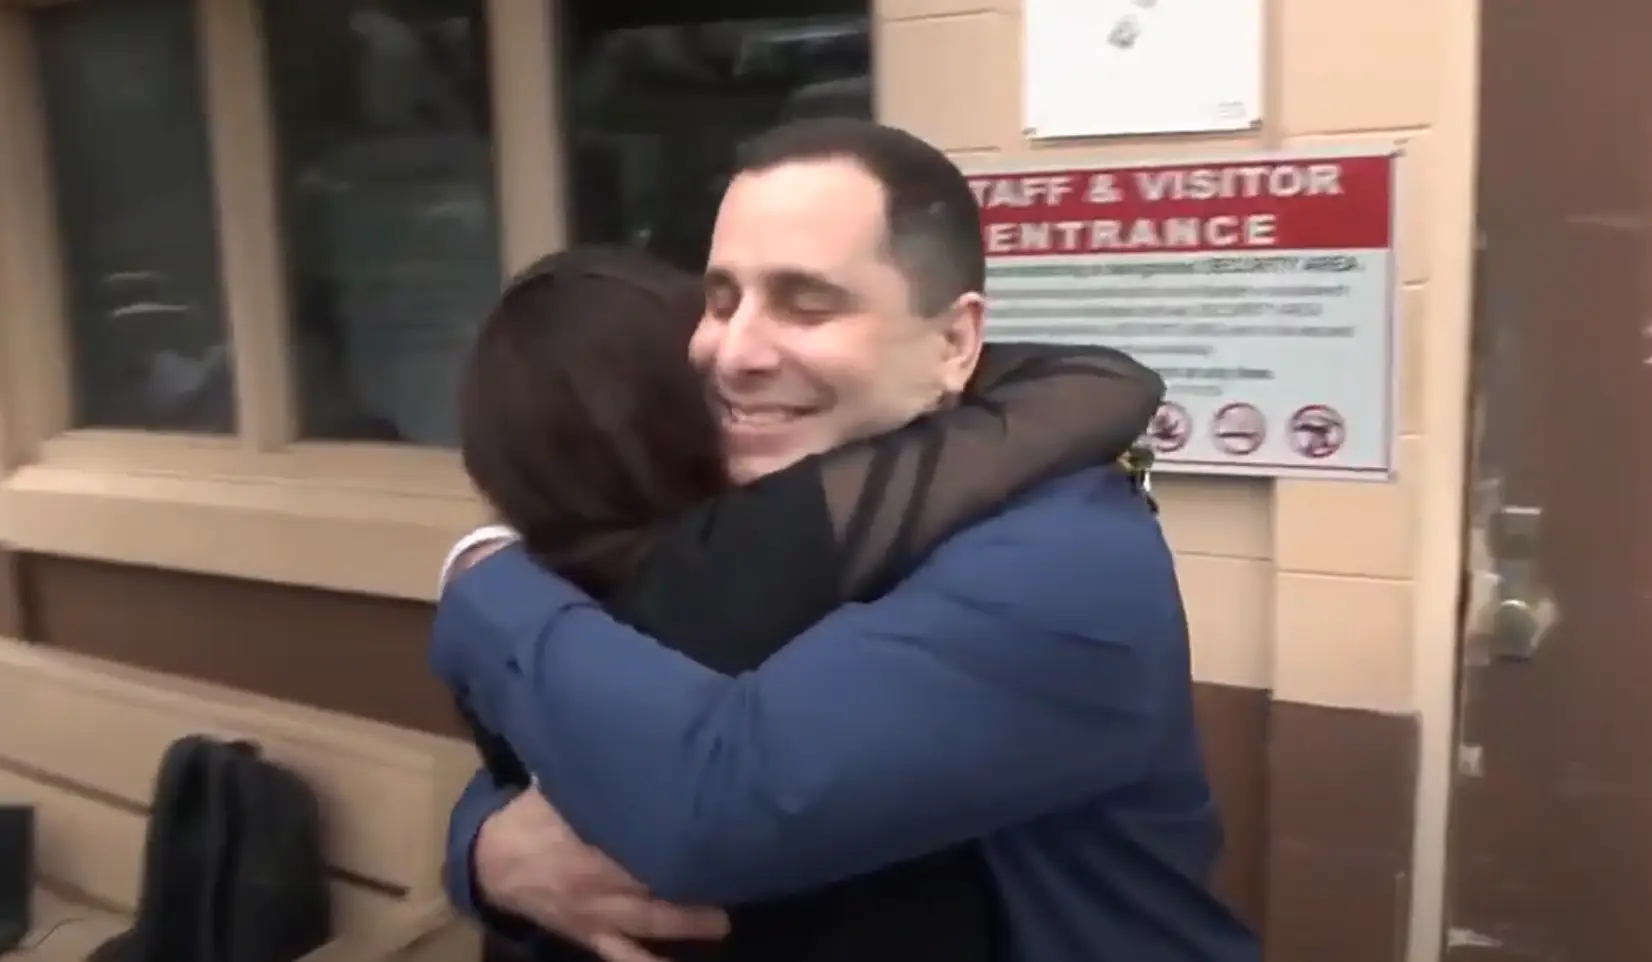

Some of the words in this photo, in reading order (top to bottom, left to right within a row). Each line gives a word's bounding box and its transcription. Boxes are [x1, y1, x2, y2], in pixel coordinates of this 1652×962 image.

[968, 176, 1073, 208] TAFF
[1083, 173, 1123, 204] &
[1135, 163, 1343, 200] VISITOR
[985, 213, 1278, 252] ENTRANCE
